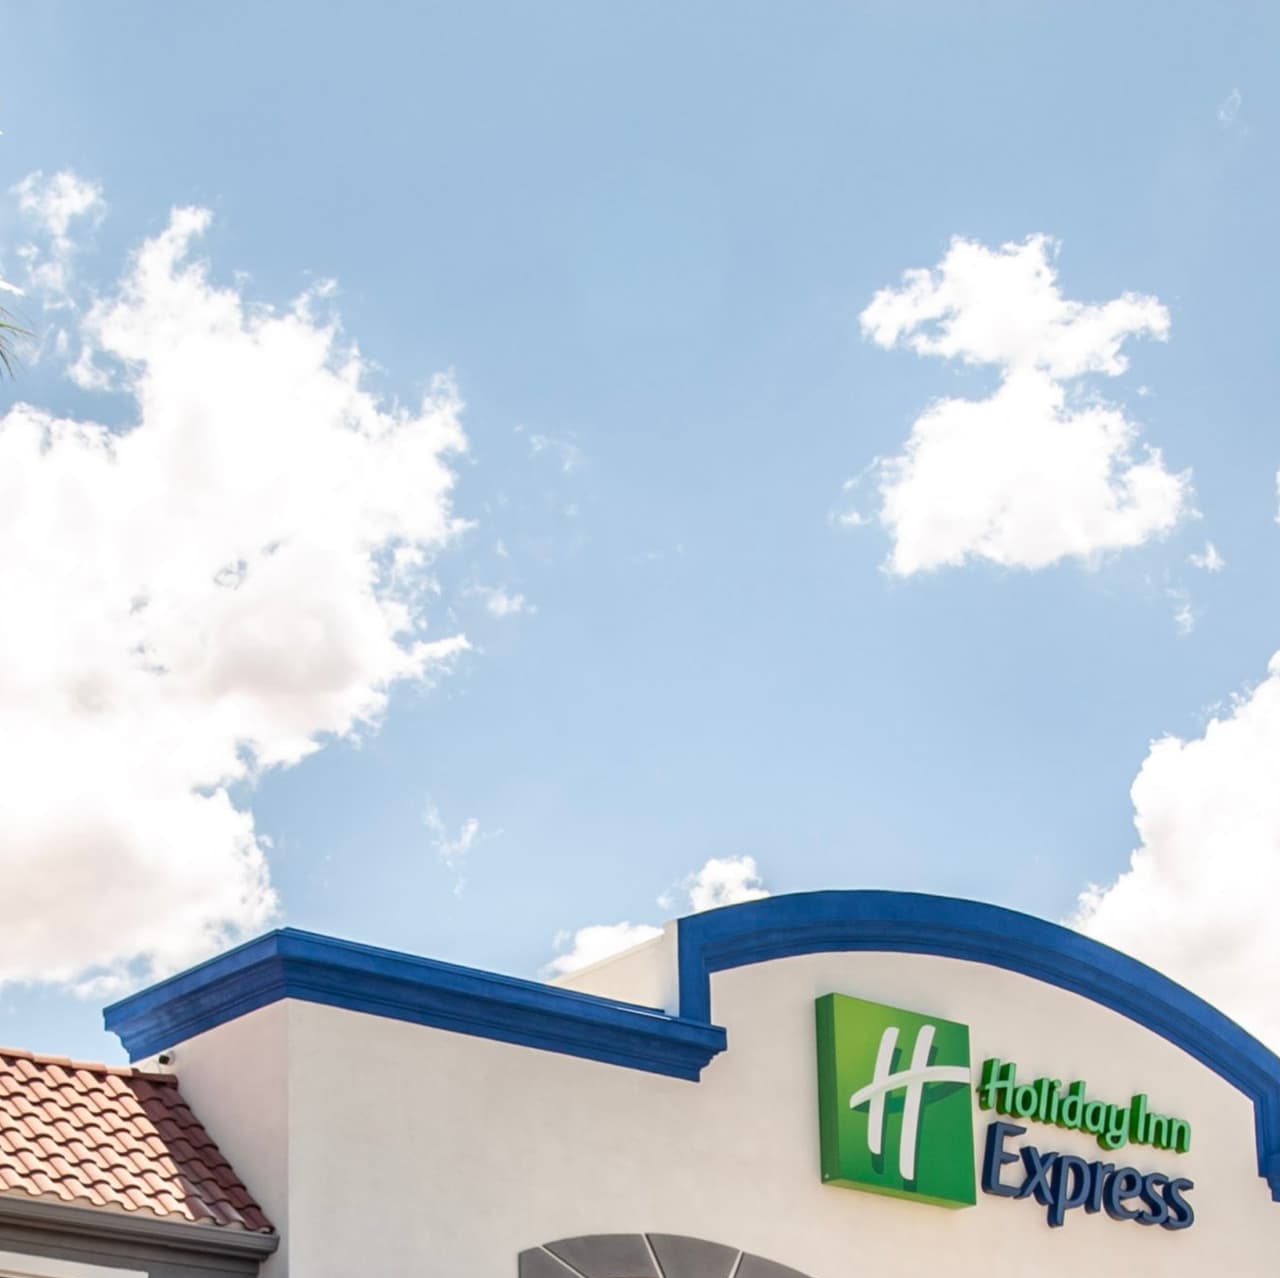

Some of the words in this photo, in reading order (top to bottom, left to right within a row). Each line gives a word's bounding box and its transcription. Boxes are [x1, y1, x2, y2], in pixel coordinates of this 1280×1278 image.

[976, 1057, 1130, 1151] Holiday
[1129, 1093, 1191, 1154] Inn
[981, 1120, 1196, 1231] Express
